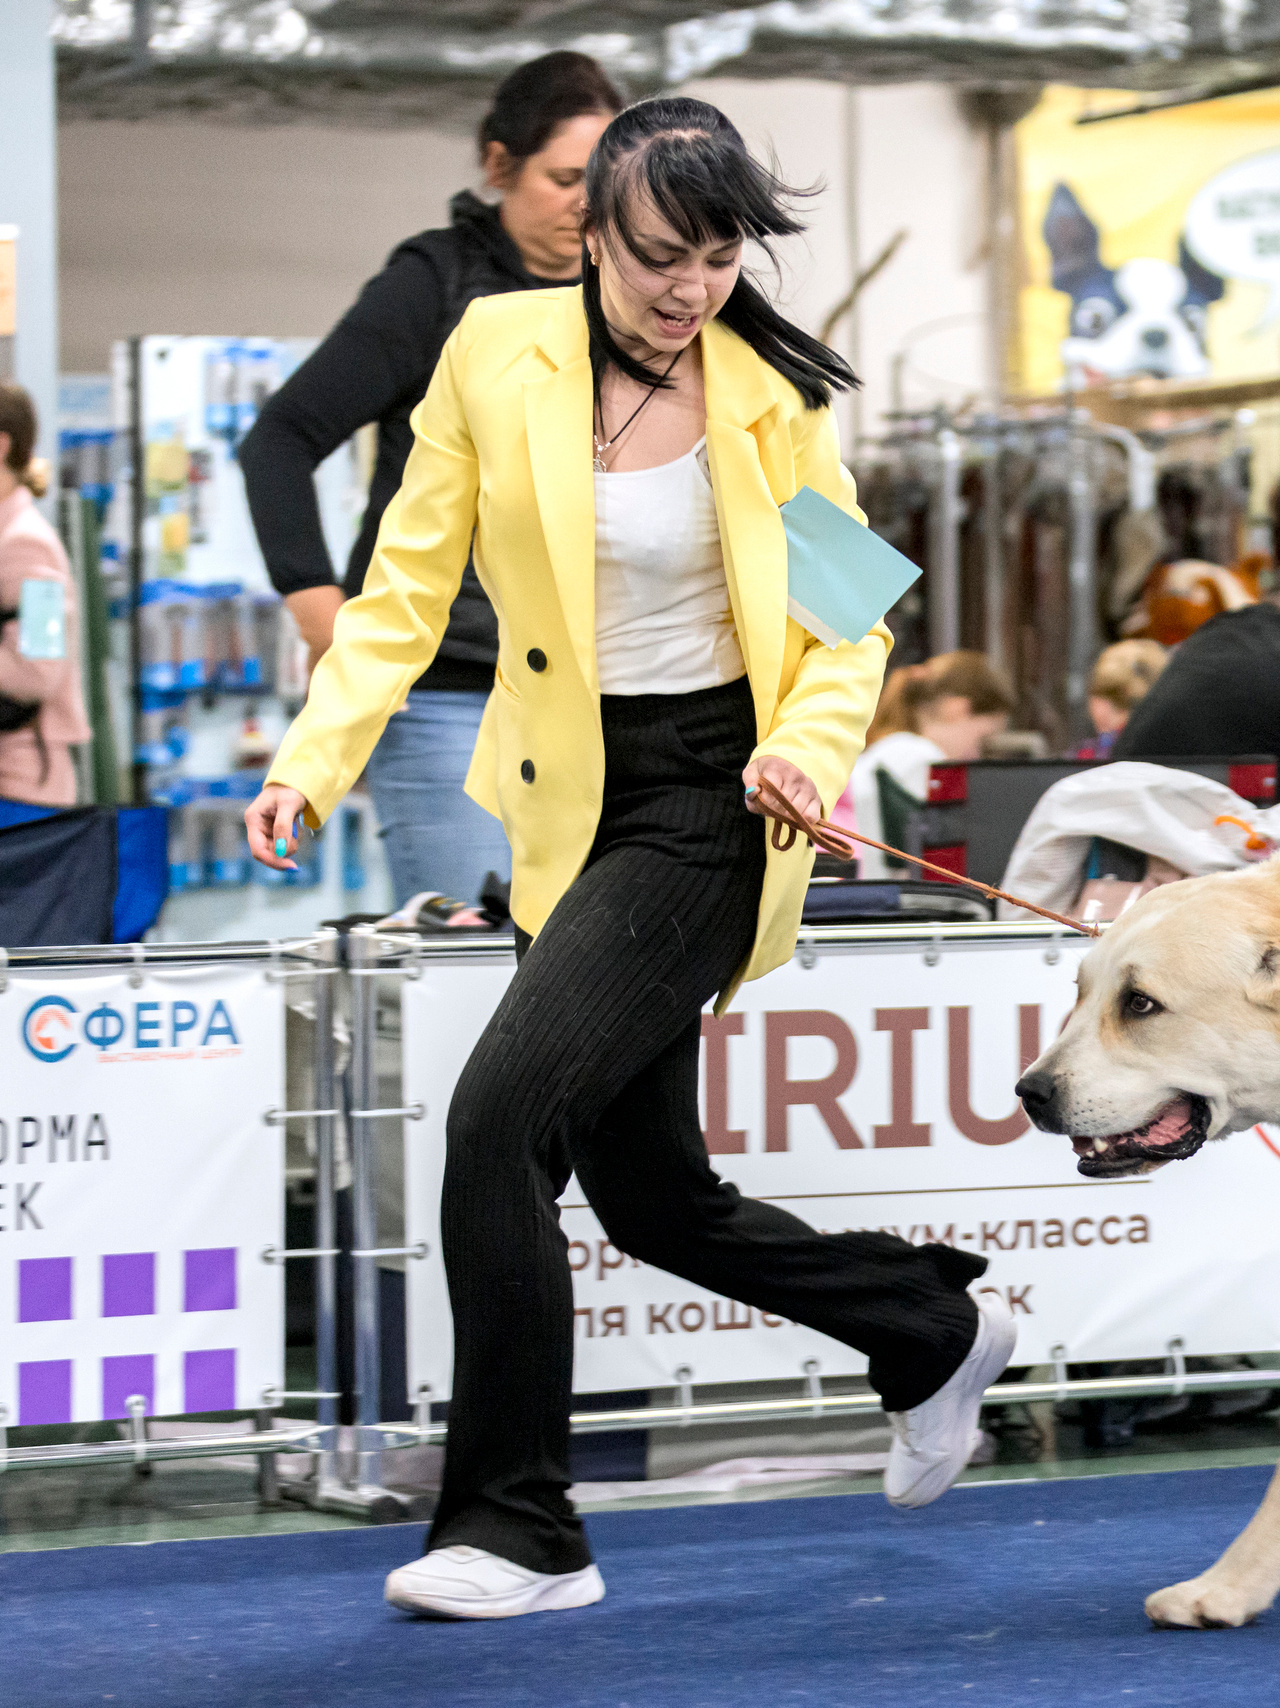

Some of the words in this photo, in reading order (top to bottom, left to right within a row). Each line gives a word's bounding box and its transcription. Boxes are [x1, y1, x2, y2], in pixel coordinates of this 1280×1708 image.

[23, 995, 240, 1063] СФЕРА
[700, 1004, 1072, 1155] IRIU
[574, 1305, 627, 1338] ля
